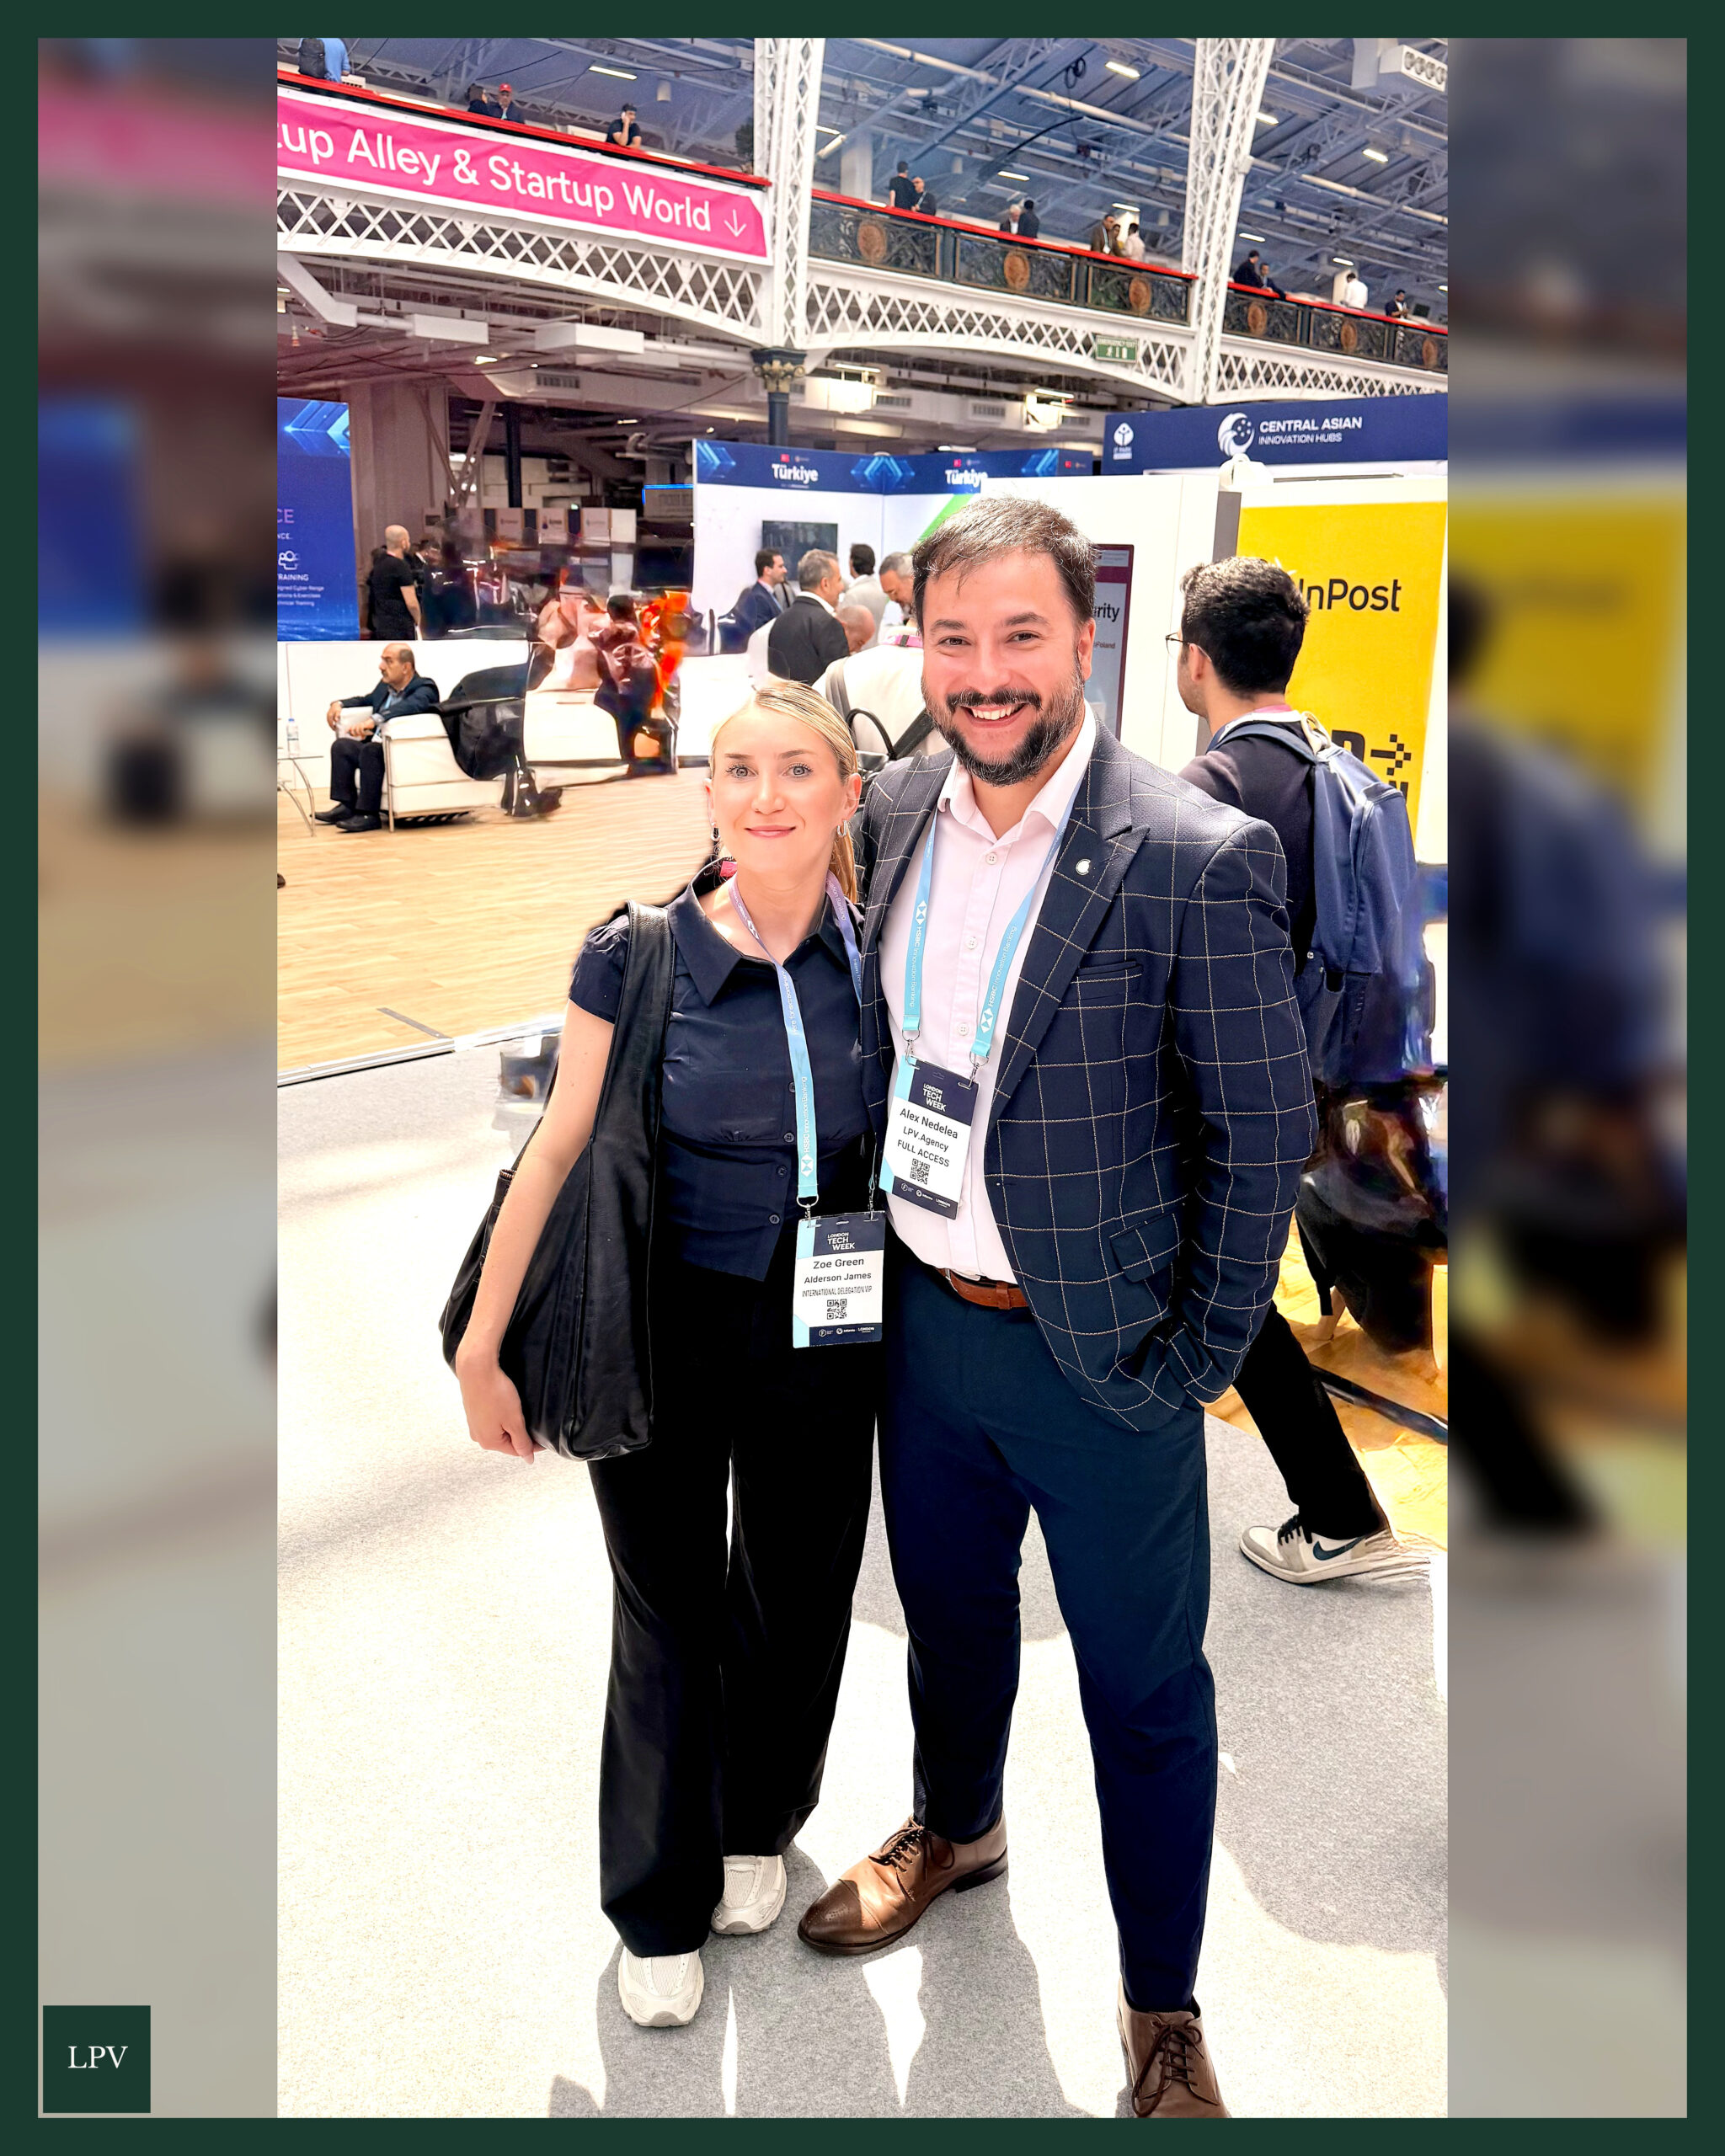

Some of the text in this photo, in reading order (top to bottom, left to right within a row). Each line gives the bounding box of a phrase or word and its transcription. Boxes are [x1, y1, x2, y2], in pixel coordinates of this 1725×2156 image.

[347, 129, 441, 186] Alley
[453, 149, 480, 185] &
[489, 156, 614, 217] Startup
[622, 182, 711, 232] World
[1259, 417, 1363, 433] CENTRAL ASIAN
[1258, 432, 1343, 445] INNOVATION HUBS
[772, 463, 819, 484] Türkiye
[987, 985, 997, 1007] HSBC
[994, 953, 1007, 985] Innovation
[922, 1088, 942, 1102] TECH
[923, 1083, 943, 1095] LONDON
[926, 1097, 947, 1113] WEEK
[900, 1108, 959, 1139] Alex Nedelea
[903, 1126, 948, 1152] LPV.Agency
[897, 1139, 950, 1167] FULL ACCESS
[827, 1236, 849, 1245] TECH
[832, 1242, 855, 1251] WEEK
[813, 1258, 864, 1270] Zoe Green
[804, 1273, 872, 1284] Alderson James
[802, 1289, 837, 1298] INTERNATIONAL
[837, 1286, 864, 1295] DELEGATION
